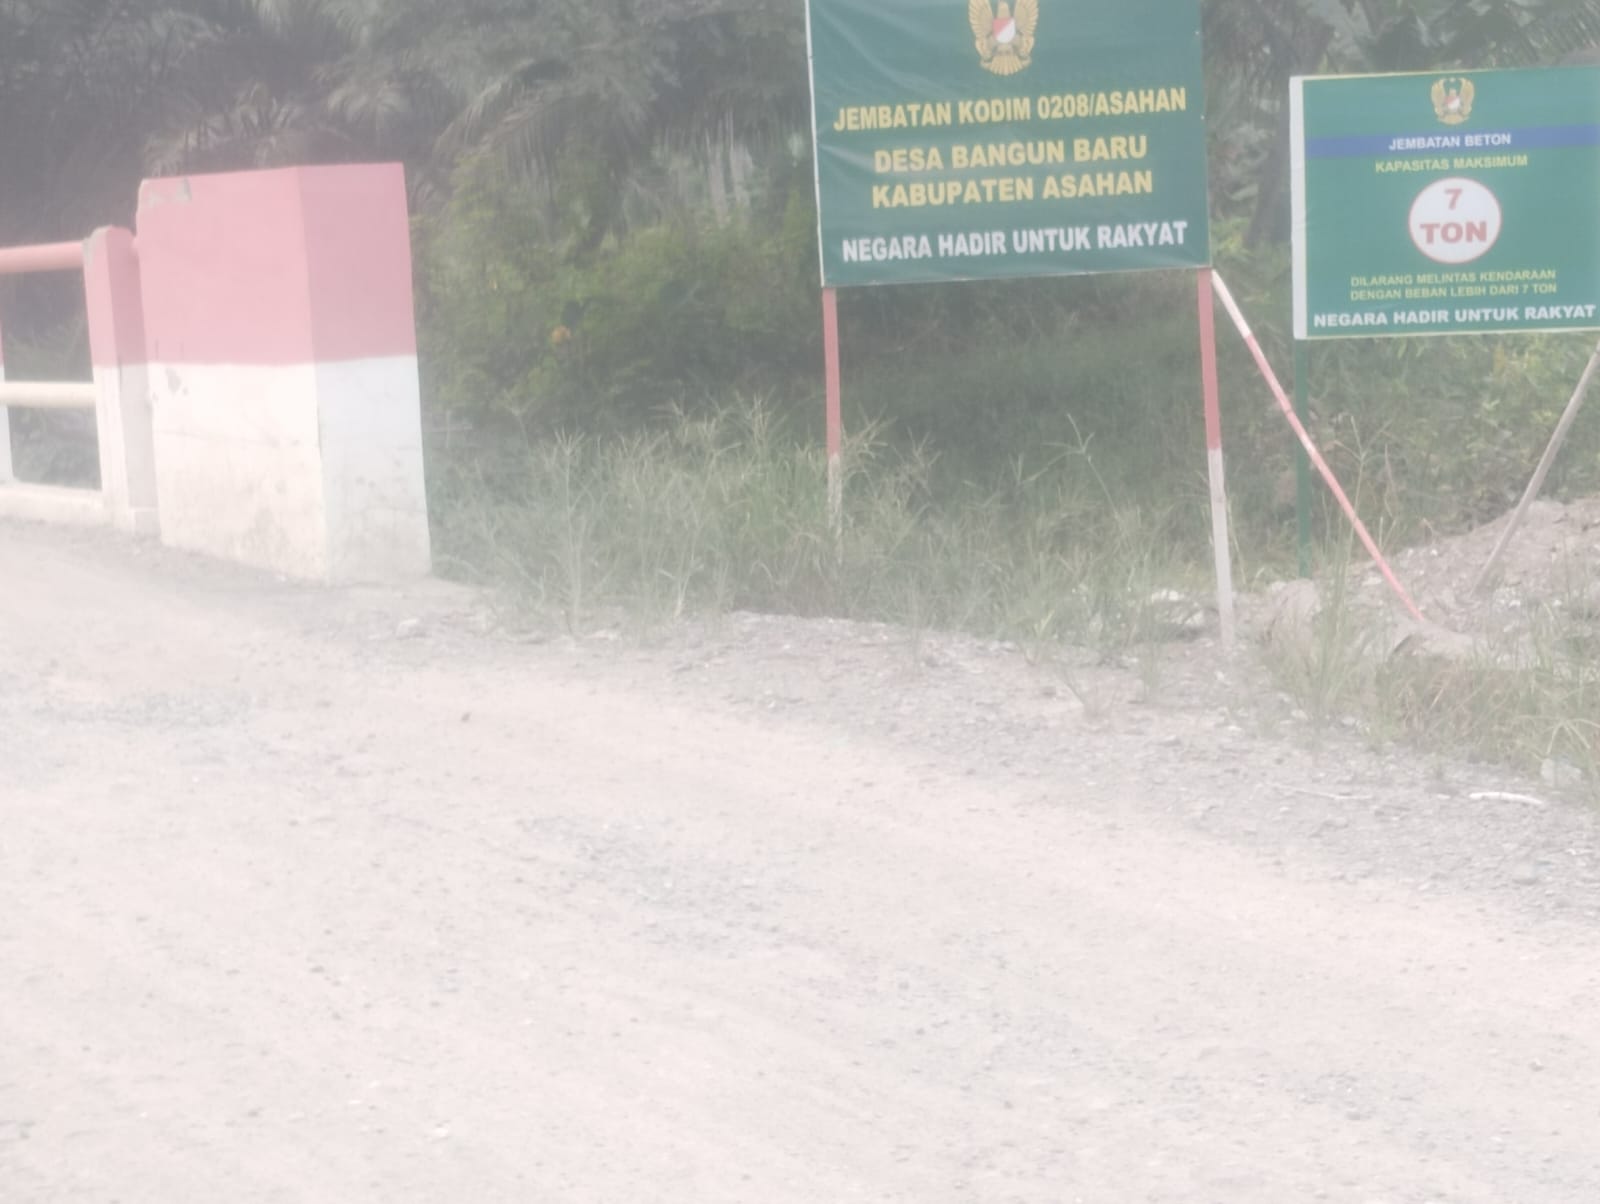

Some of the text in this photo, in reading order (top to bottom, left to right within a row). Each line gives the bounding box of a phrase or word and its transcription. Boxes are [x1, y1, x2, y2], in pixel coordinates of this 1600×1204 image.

[834, 88, 1186, 131] JEMBATAN KODIM 0208/ASAHAN
[1389, 134, 1510, 150] JEMBATAN BETON
[875, 136, 1147, 173] DESA BANGUN BARU
[1376, 155, 1528, 173] KAPASITAS MAKSIMUM
[873, 171, 1152, 208] KABUPATEN ASAHAN
[1444, 188, 1462, 210] 7
[843, 222, 1187, 263] NEGARA HADIR UNTUK RAKYAT
[1420, 221, 1487, 244] TON
[1351, 270, 1556, 287] DILARANG MELINTAS KENDARAAN
[1351, 282, 1556, 300] DENGAN BEBAN LEBIH DARI 7 TON
[1314, 304, 1596, 328] NEGARA HADIR UNTUK RAKYAT
